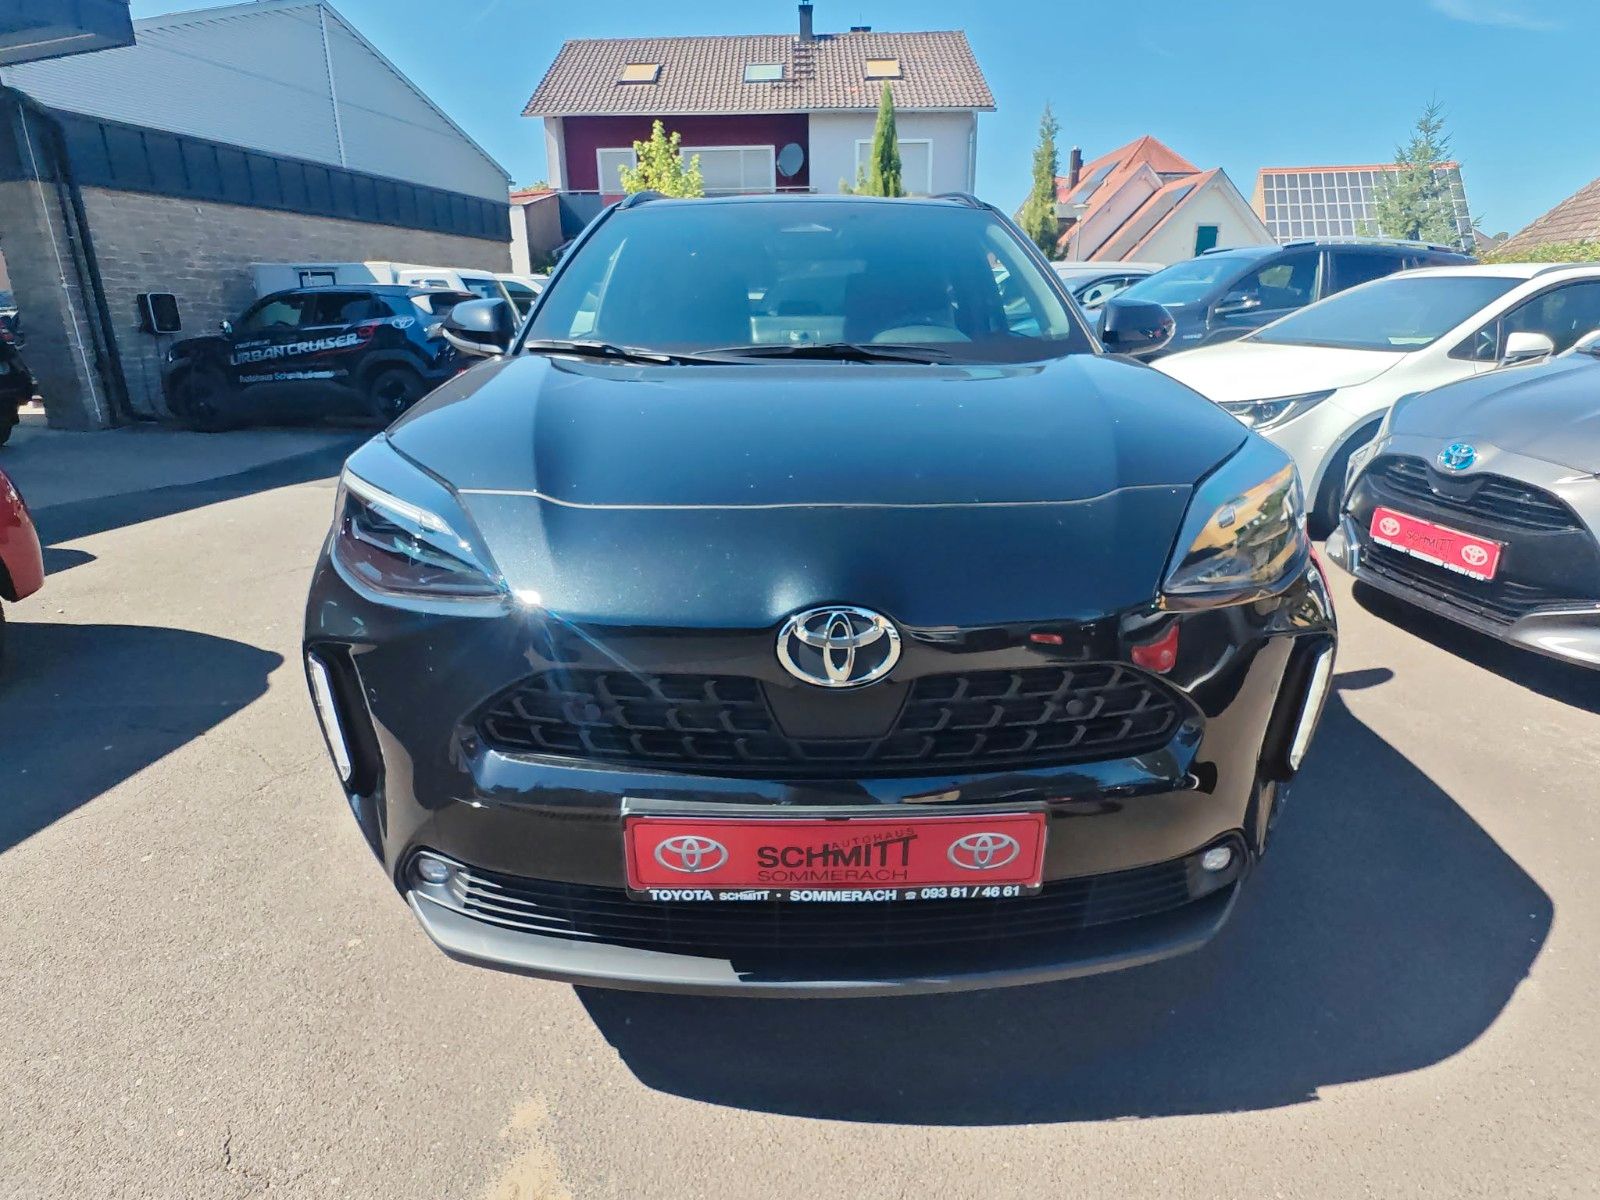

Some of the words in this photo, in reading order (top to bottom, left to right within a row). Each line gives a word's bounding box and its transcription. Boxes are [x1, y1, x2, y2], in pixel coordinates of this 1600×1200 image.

[230, 345, 286, 365] URBAN
[286, 333, 360, 354] CRUISER
[1406, 529, 1456, 552] SCHMITT
[832, 827, 915, 849] AUTOHAUS
[757, 834, 918, 869] SCHMITT
[757, 869, 908, 882] SOMMERACH
[649, 889, 714, 901] TOYOTA
[719, 890, 770, 901] SCHMITT
[789, 889, 897, 902] SOMMERACH
[920, 887, 949, 899] 093
[950, 886, 968, 898] 81
[981, 885, 1000, 898] 46
[1002, 885, 1020, 897] 61
